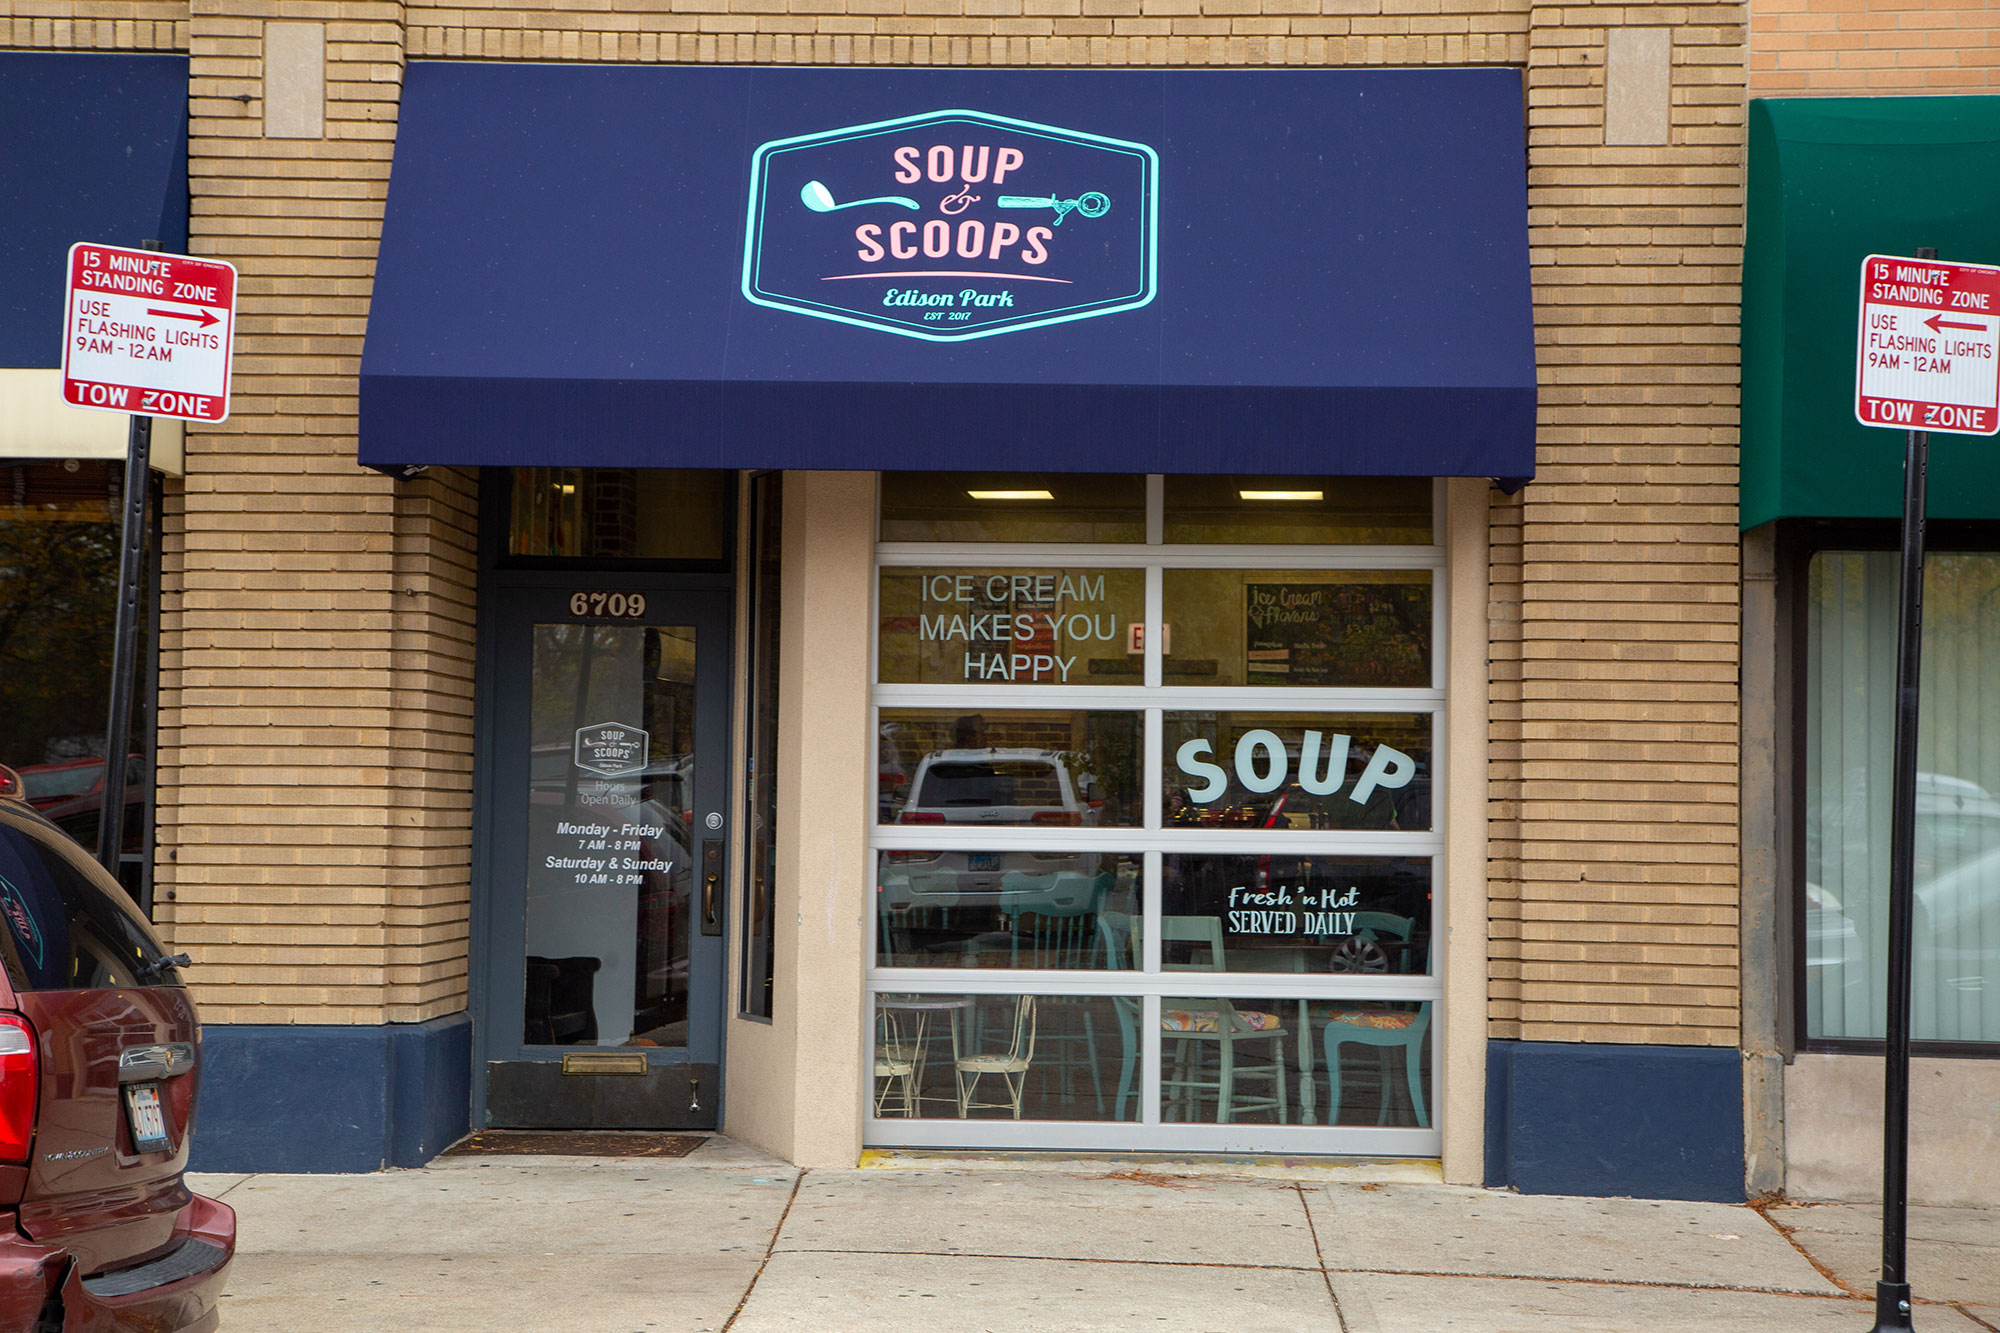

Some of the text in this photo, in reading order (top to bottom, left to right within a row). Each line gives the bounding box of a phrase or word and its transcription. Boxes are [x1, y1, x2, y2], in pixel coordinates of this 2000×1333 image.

[894, 145, 1024, 184] SOUP
[940, 184, 981, 215] &
[855, 219, 1053, 264] SCOOPS
[82, 251, 172, 278] 15 MINUTE
[1873, 263, 1950, 287] 15 MINUTE
[81, 270, 217, 302] STANDING ZONE
[882, 288, 1014, 307] Edison Park
[1872, 283, 1990, 309] STANDING ZONE
[79, 299, 111, 317] USE
[923, 311, 972, 320] EST 2017
[78, 318, 219, 350] FLASHING LIGHTS
[1871, 314, 1897, 331] USE
[1869, 332, 1992, 359] FLASHING LIGHTS
[74, 382, 211, 417] TOW ZONE
[1867, 399, 1986, 429] TOW ZONE
[921, 575, 1105, 602] ICE CREAM
[570, 592, 646, 617] 6709
[919, 614, 1036, 641] MAKES
[1044, 614, 1116, 641] YOU
[963, 652, 1078, 682] HAPPY
[600, 730, 625, 741] SOUP
[594, 747, 630, 759] SCOOPS
[1176, 729, 1416, 806] SOUP
[595, 780, 625, 791] Hours
[581, 793, 637, 808] Open Daily
[556, 822, 610, 837] Monday
[620, 823, 663, 839] Friday
[578, 840, 584, 849] 7
[586, 840, 605, 850] AM
[615, 840, 621, 850] 8
[623, 840, 641, 850] PM
[545, 856, 673, 873] Saturday & Sunday
[574, 874, 586, 883] 10
[589, 874, 607, 884] AM
[617, 874, 624, 884] 8
[625, 875, 643, 885] PM
[1228, 886, 1293, 908] Fresh
[1321, 886, 1361, 909] Hot
[1228, 910, 1356, 935] SERVED DAILY
